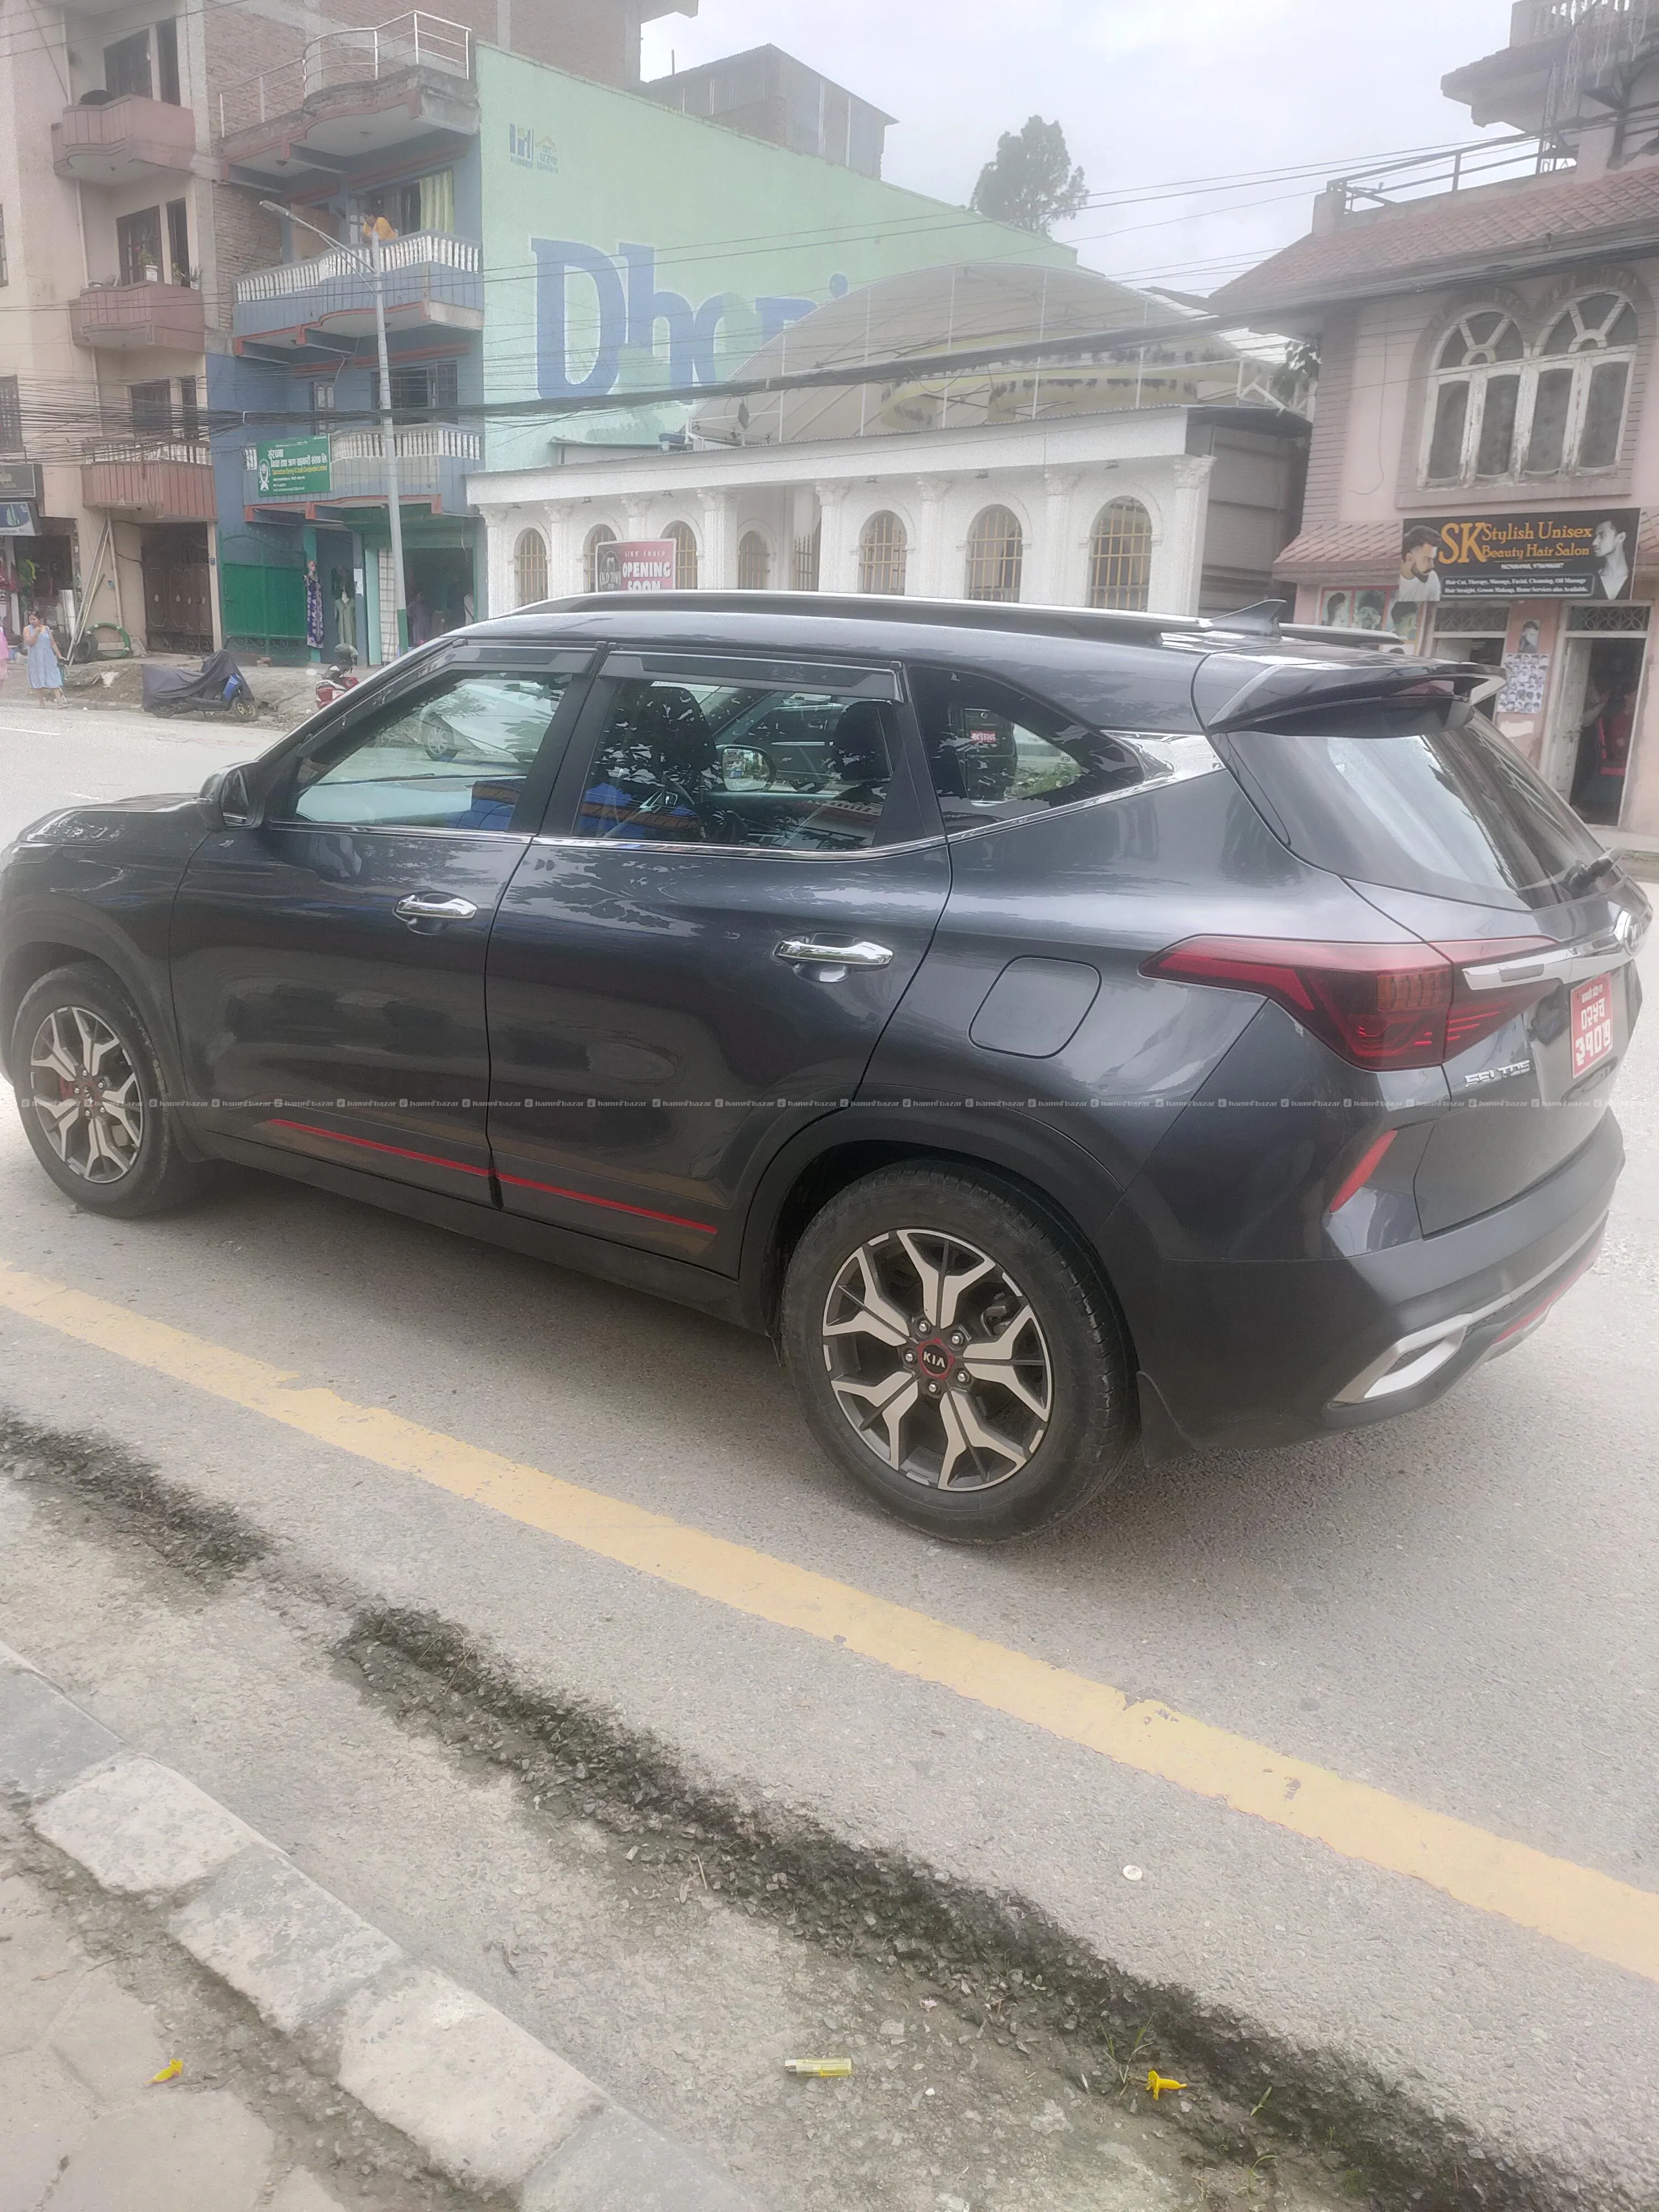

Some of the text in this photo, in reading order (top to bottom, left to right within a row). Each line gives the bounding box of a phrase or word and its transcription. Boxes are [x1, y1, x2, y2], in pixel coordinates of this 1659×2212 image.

[1481, 521, 1593, 544] Stylish Unisex
[1438, 521, 1489, 565] SK
[1481, 542, 1590, 560] Beauty Hair Salon
[622, 561, 671, 578] OPENING
[628, 580, 661, 591] SOON
[922, 1350, 946, 1369] KIA
